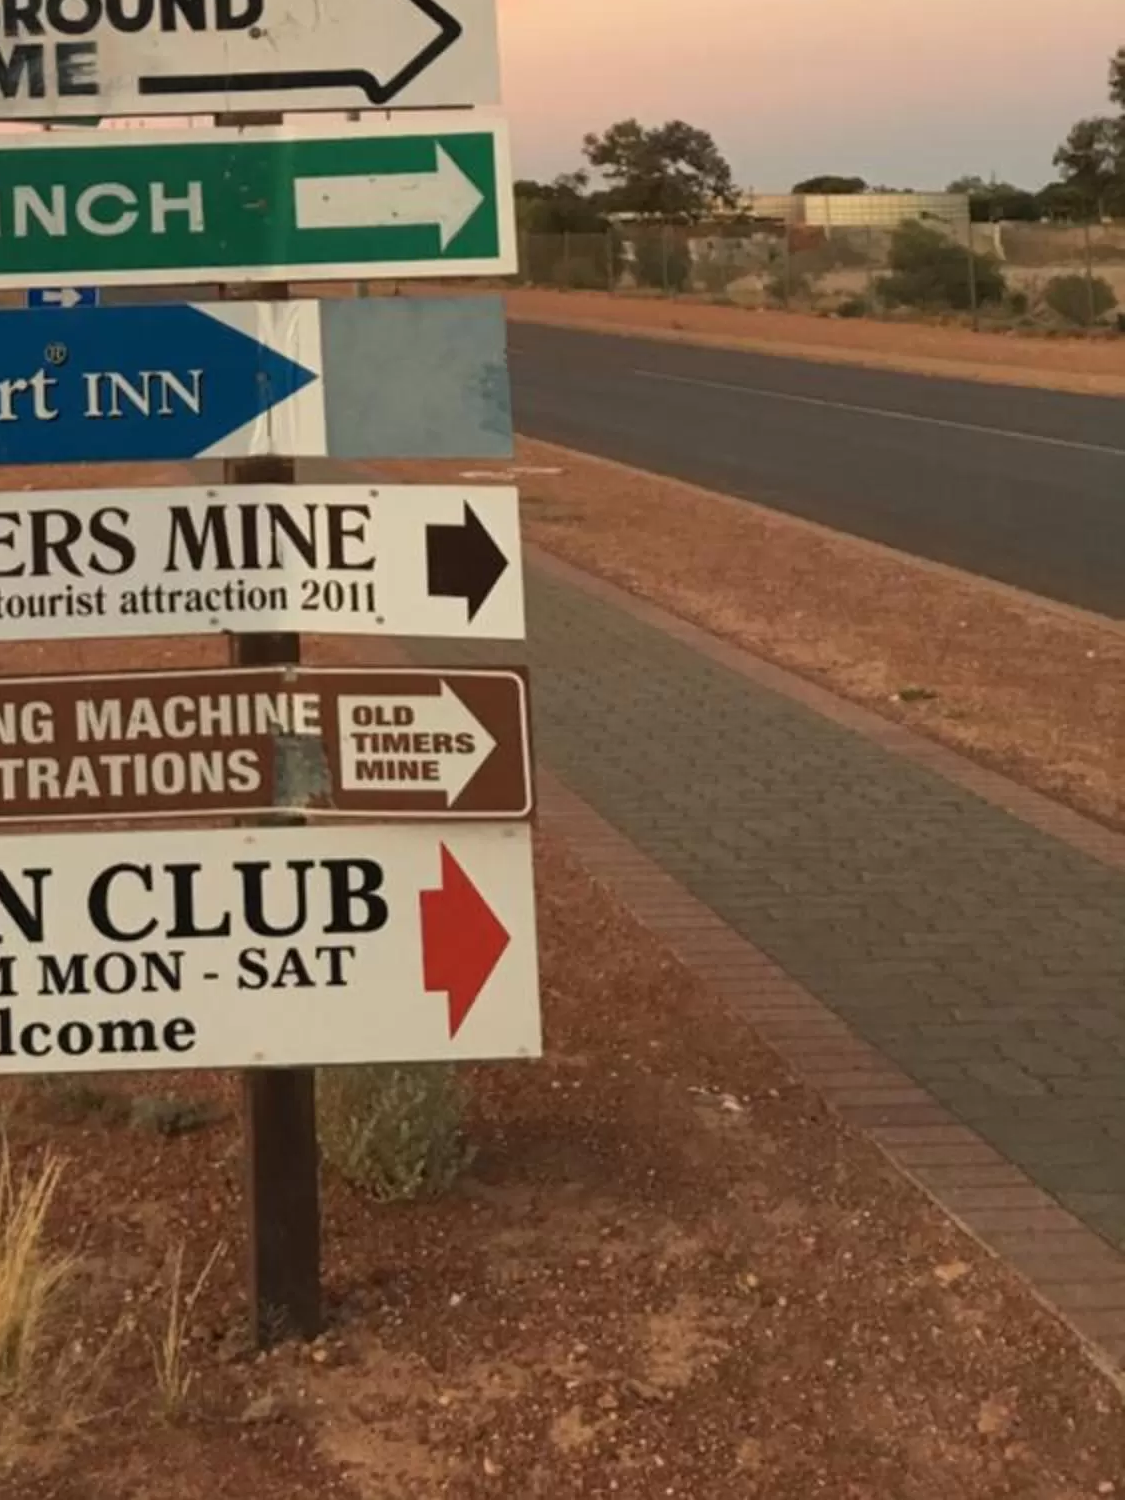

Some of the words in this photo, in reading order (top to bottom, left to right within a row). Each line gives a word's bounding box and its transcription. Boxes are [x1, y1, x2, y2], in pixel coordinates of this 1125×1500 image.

[83, 368, 203, 417] INN
[166, 503, 376, 573] MINE
[120, 581, 288, 615] attraction
[300, 579, 376, 614] 2011
[76, 693, 322, 745] MACHINE
[351, 704, 414, 728] OLD
[350, 732, 475, 756] TIMERS
[354, 759, 441, 782] MINE
[88, 859, 389, 942] CLUB
[37, 951, 186, 997] MON
[237, 946, 355, 990] SAT
